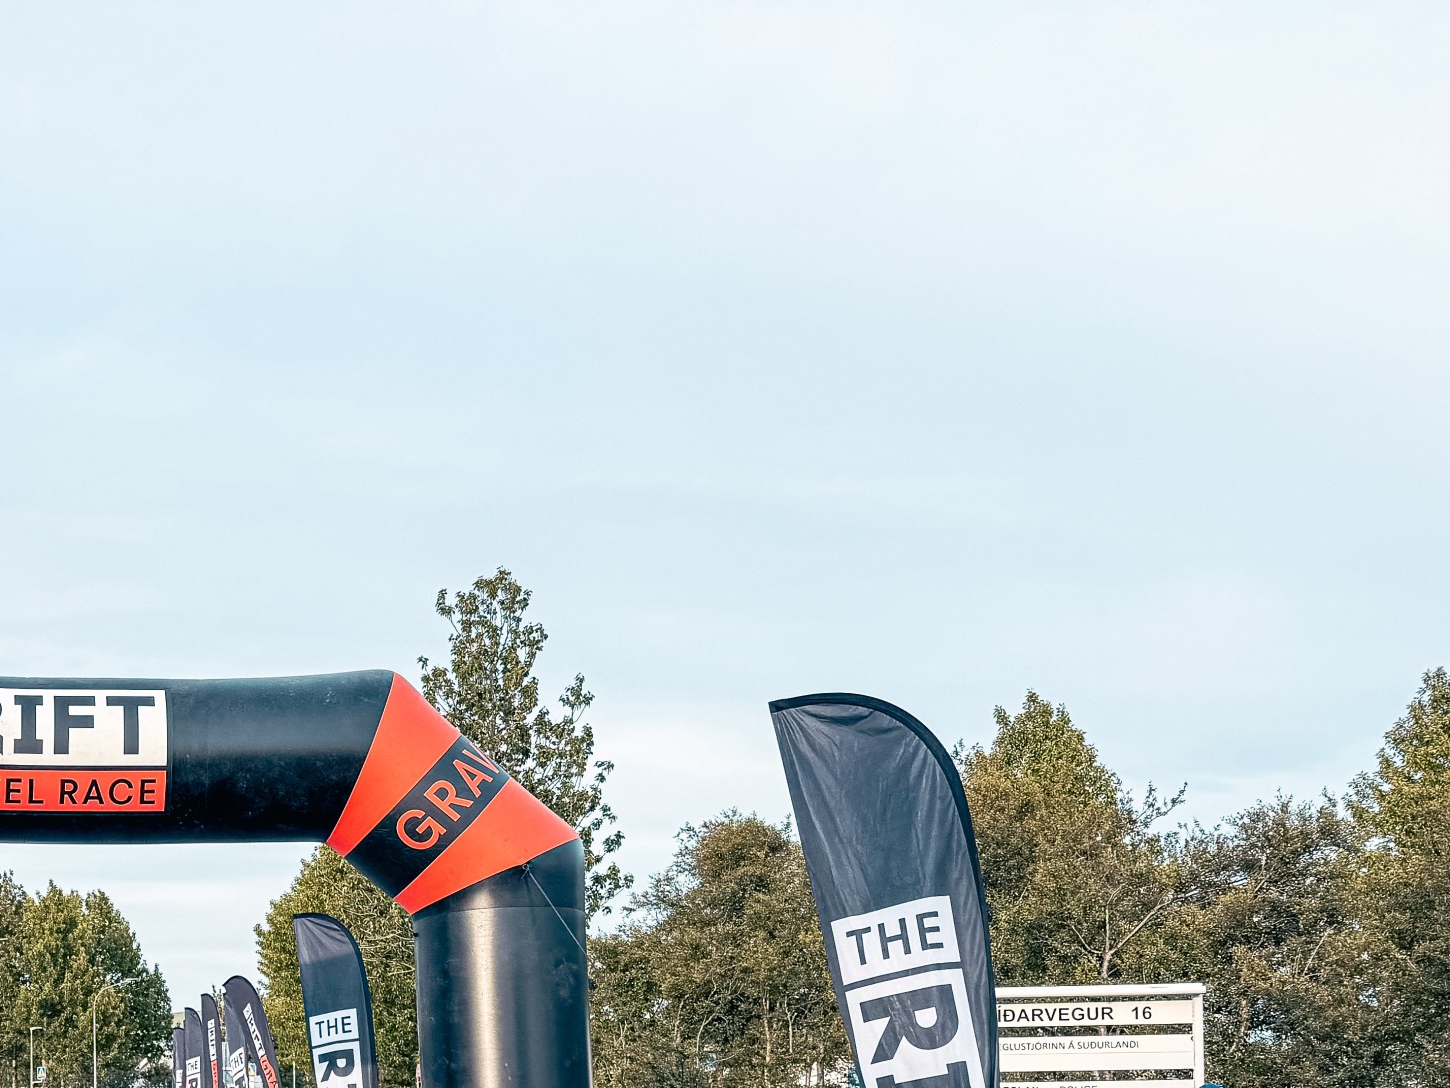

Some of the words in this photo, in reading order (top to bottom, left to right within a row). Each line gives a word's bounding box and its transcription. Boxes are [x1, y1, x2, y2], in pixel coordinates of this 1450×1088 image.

[59, 778, 157, 806] RACE
[846, 911, 944, 966] THE
[1131, 1006, 1153, 1020] 16
[315, 1016, 353, 1039] THE
[999, 1041, 1066, 1051] GLUSTJÓRINN
[1068, 1040, 1075, 1050] Á
